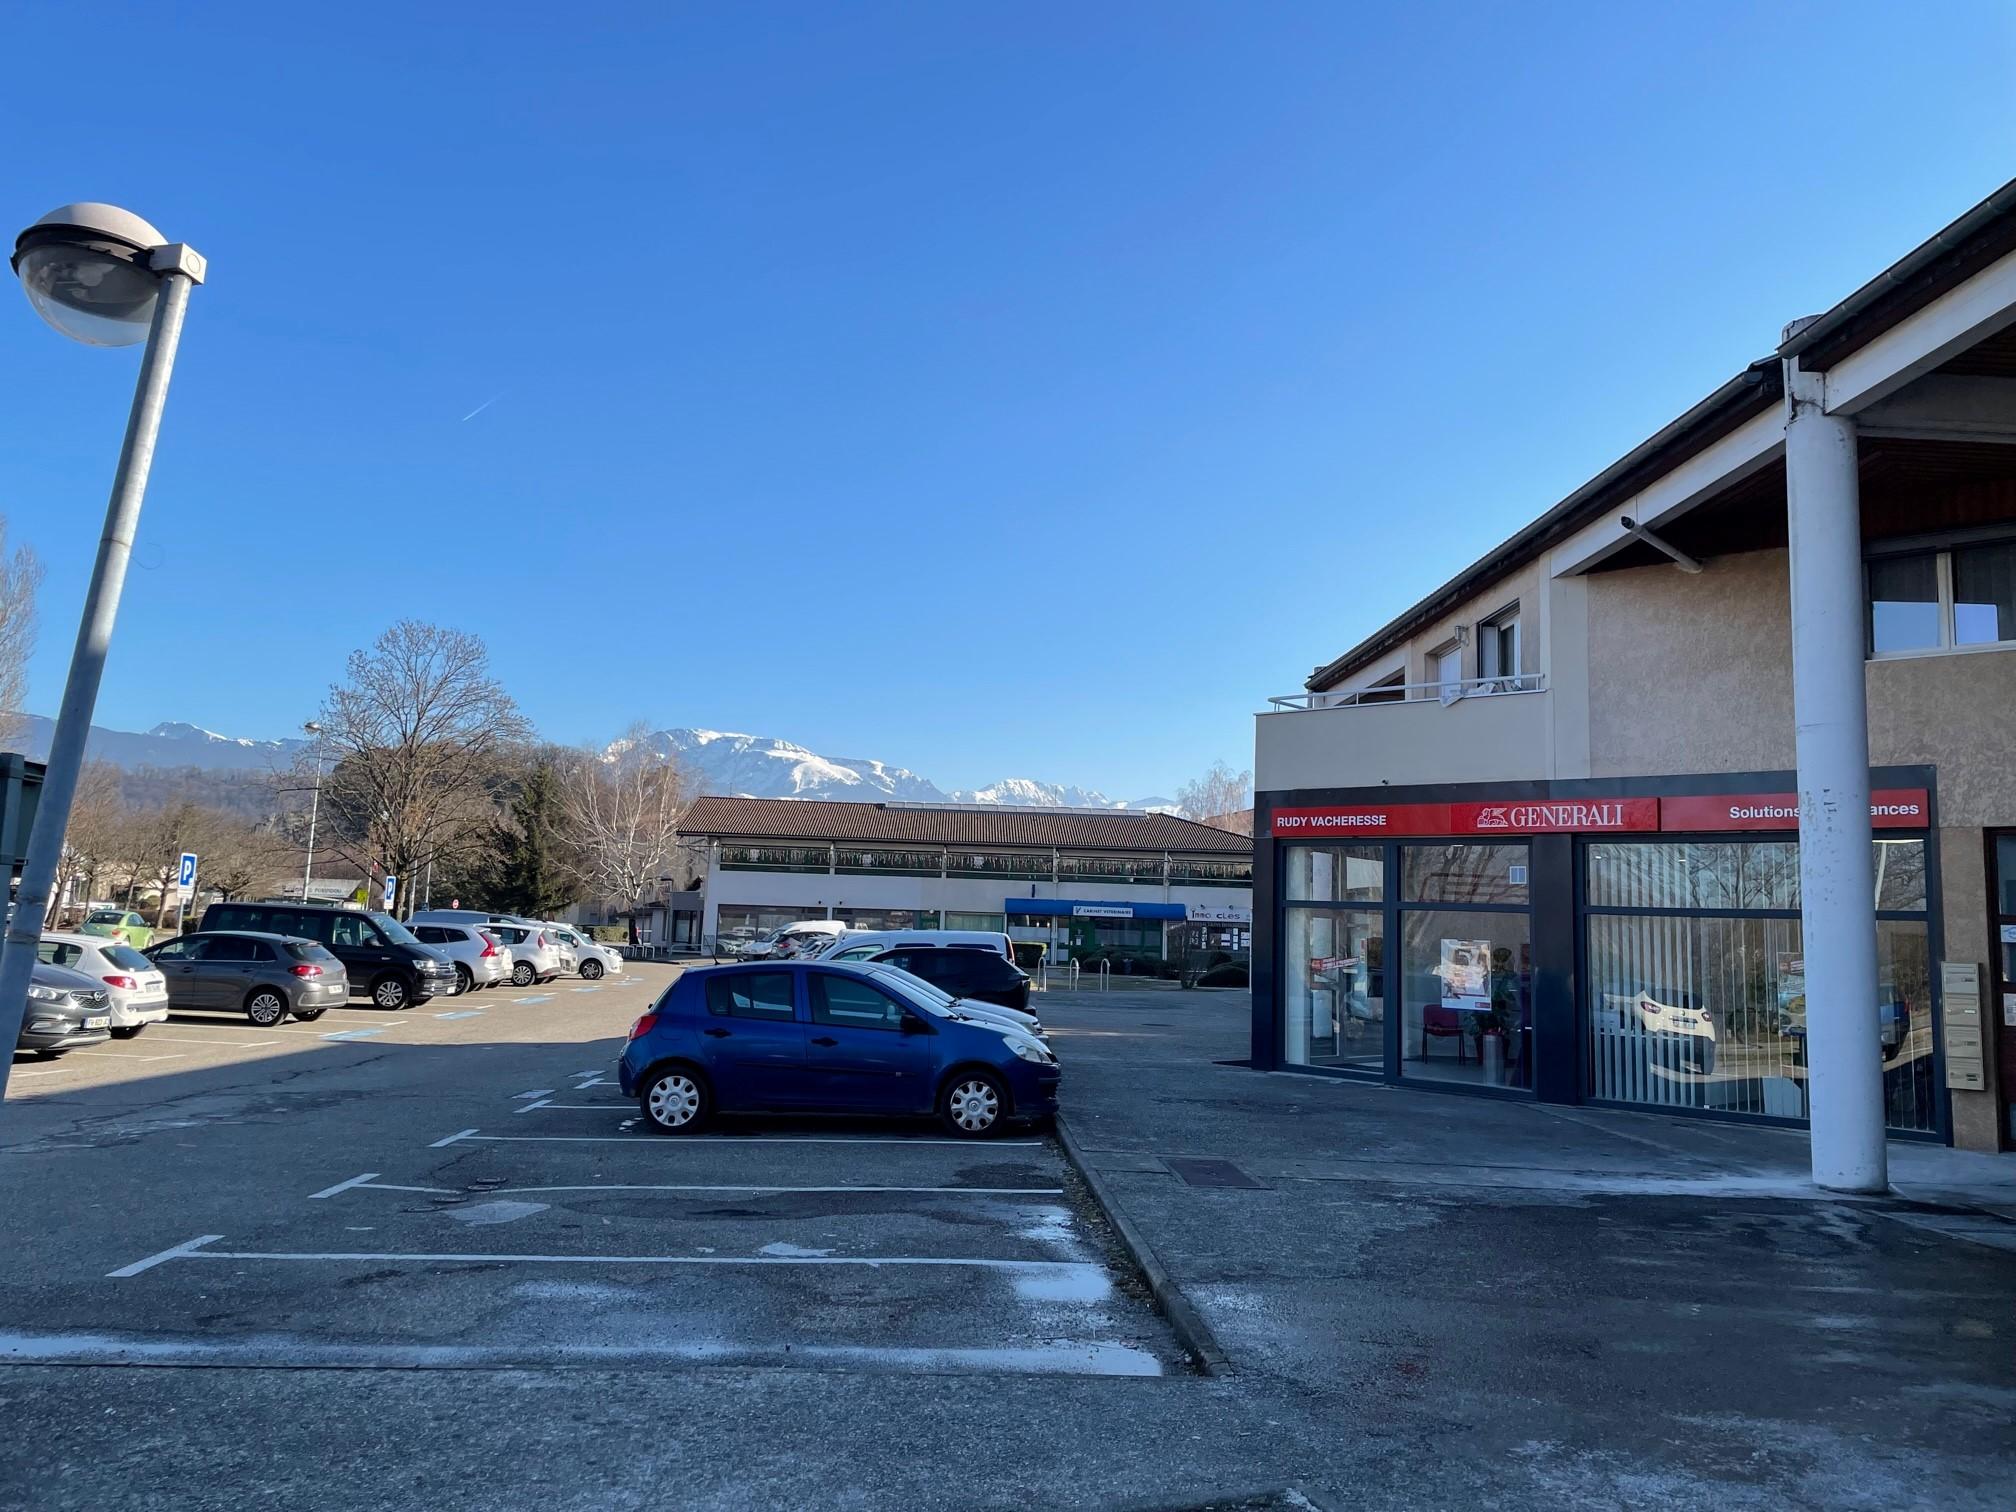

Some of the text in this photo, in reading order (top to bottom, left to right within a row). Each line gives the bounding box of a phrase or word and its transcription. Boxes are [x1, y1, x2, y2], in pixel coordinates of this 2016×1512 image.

[1510, 804, 1624, 827] GENERALI
[1729, 806, 1800, 819] Solutions
[1277, 815, 1387, 827] RUDY VACHERESSE
[183, 860, 192, 881] P
[387, 881, 394, 897] P
